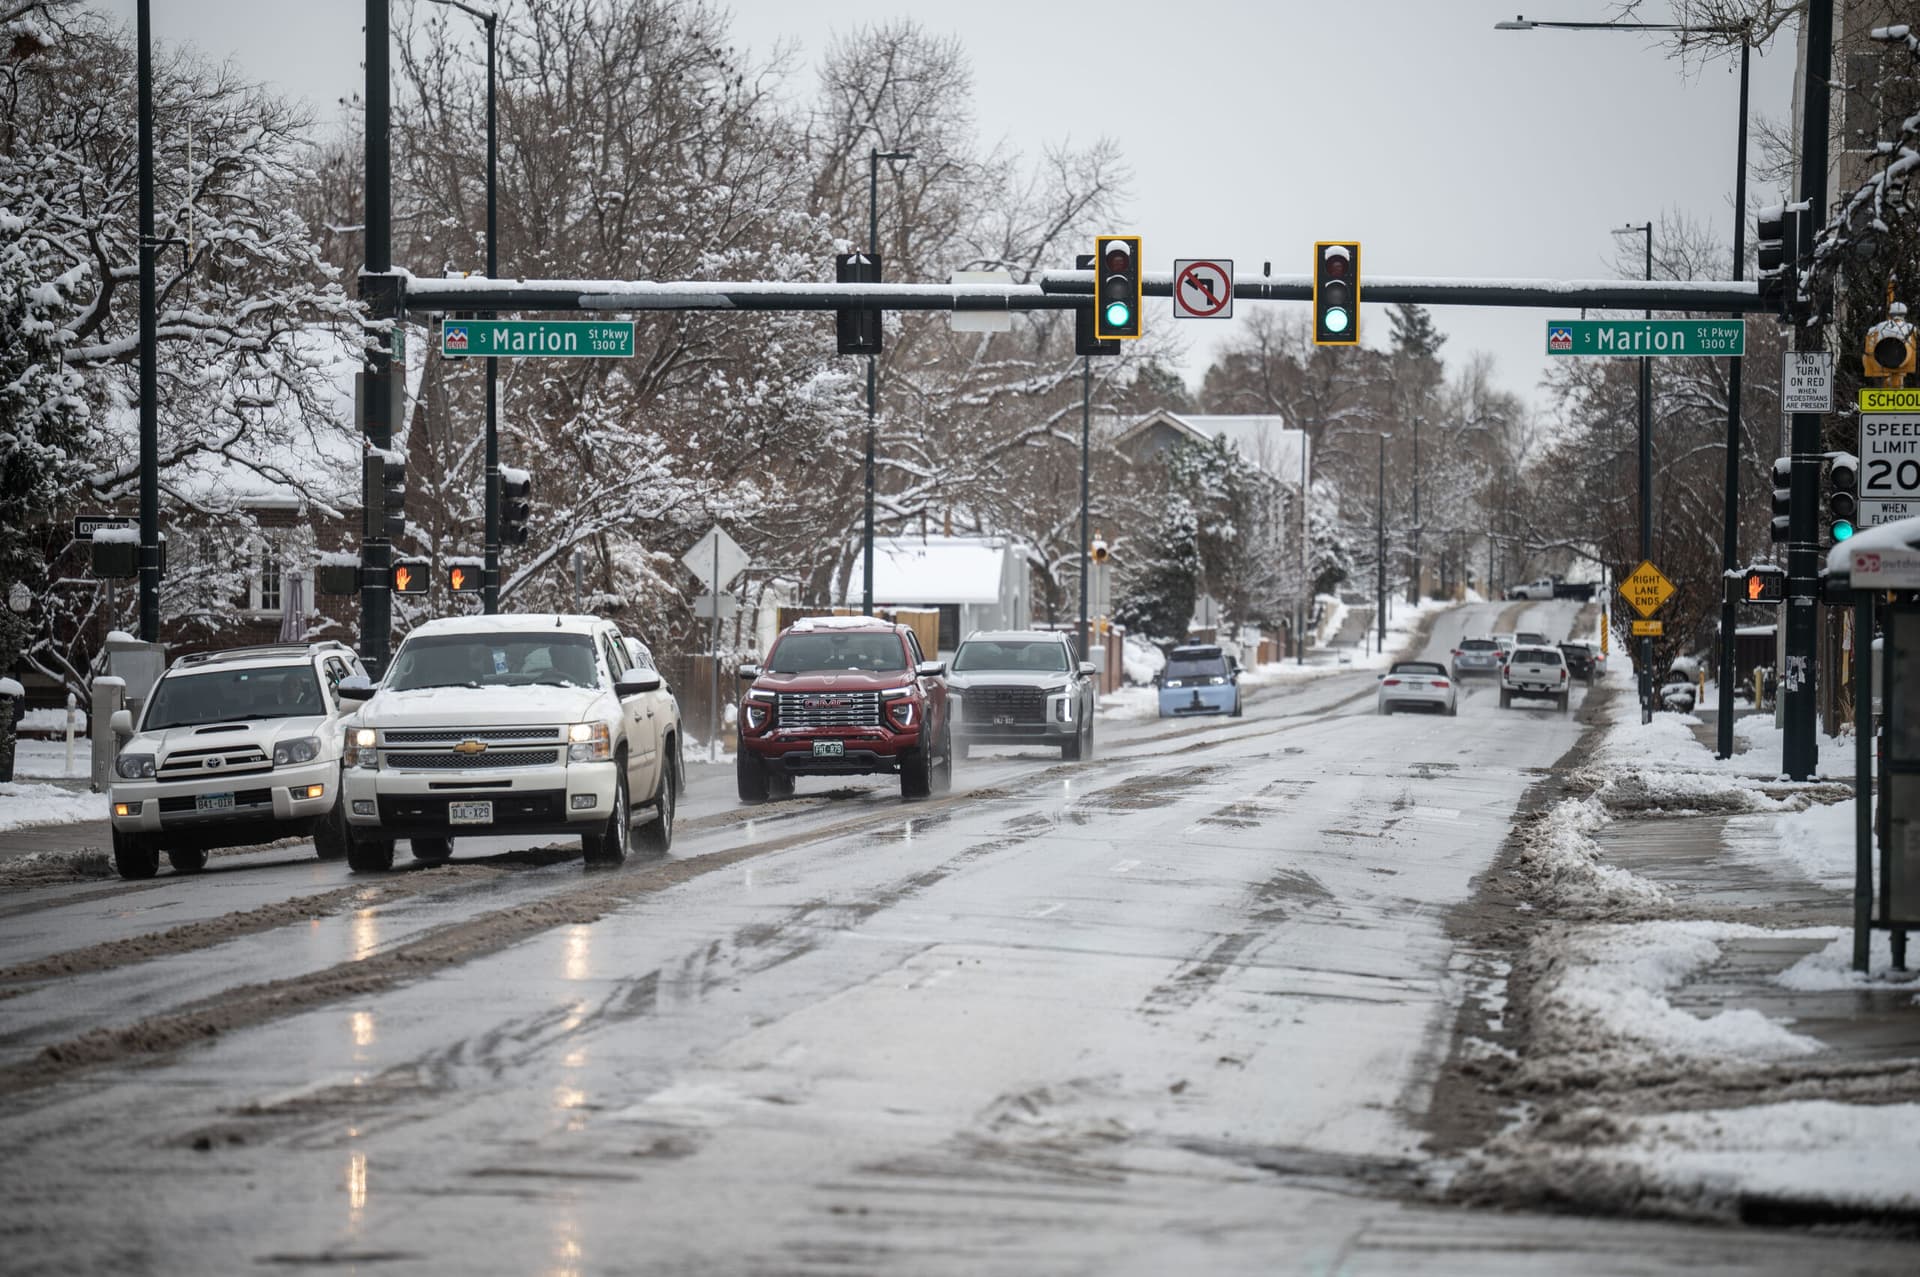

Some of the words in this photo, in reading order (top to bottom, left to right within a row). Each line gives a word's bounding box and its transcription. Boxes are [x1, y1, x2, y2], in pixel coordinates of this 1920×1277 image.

[480, 333, 486, 343] S
[493, 327, 577, 351] Marion
[588, 330, 598, 339] St
[602, 329, 629, 342] Pkwy
[1584, 332, 1590, 342] S
[1598, 326, 1685, 350] Marion
[1697, 328, 1707, 338] St
[1712, 328, 1739, 341] Pkwy
[592, 341, 616, 350] 1300
[620, 341, 625, 350] E
[1701, 339, 1725, 349] 1300
[1730, 340, 1735, 349] E
[1802, 356, 1814, 365] NO
[1796, 366, 1820, 376] TURN
[1791, 377, 1803, 387] ON
[1807, 377, 1824, 387] RED
[1868, 394, 1920, 407] SCHOOL
[1866, 424, 1920, 436] SPEED
[1872, 441, 1917, 454] LIMIT
[1867, 460, 1920, 490] 20
[1881, 504, 1907, 513] WHEN
[1872, 515, 1915, 524] FLASH
[82, 523, 103, 532] ONE
[1633, 576, 1660, 584] RIGHT
[1634, 586, 1659, 595] LANE
[1635, 597, 1659, 605] ENDS
